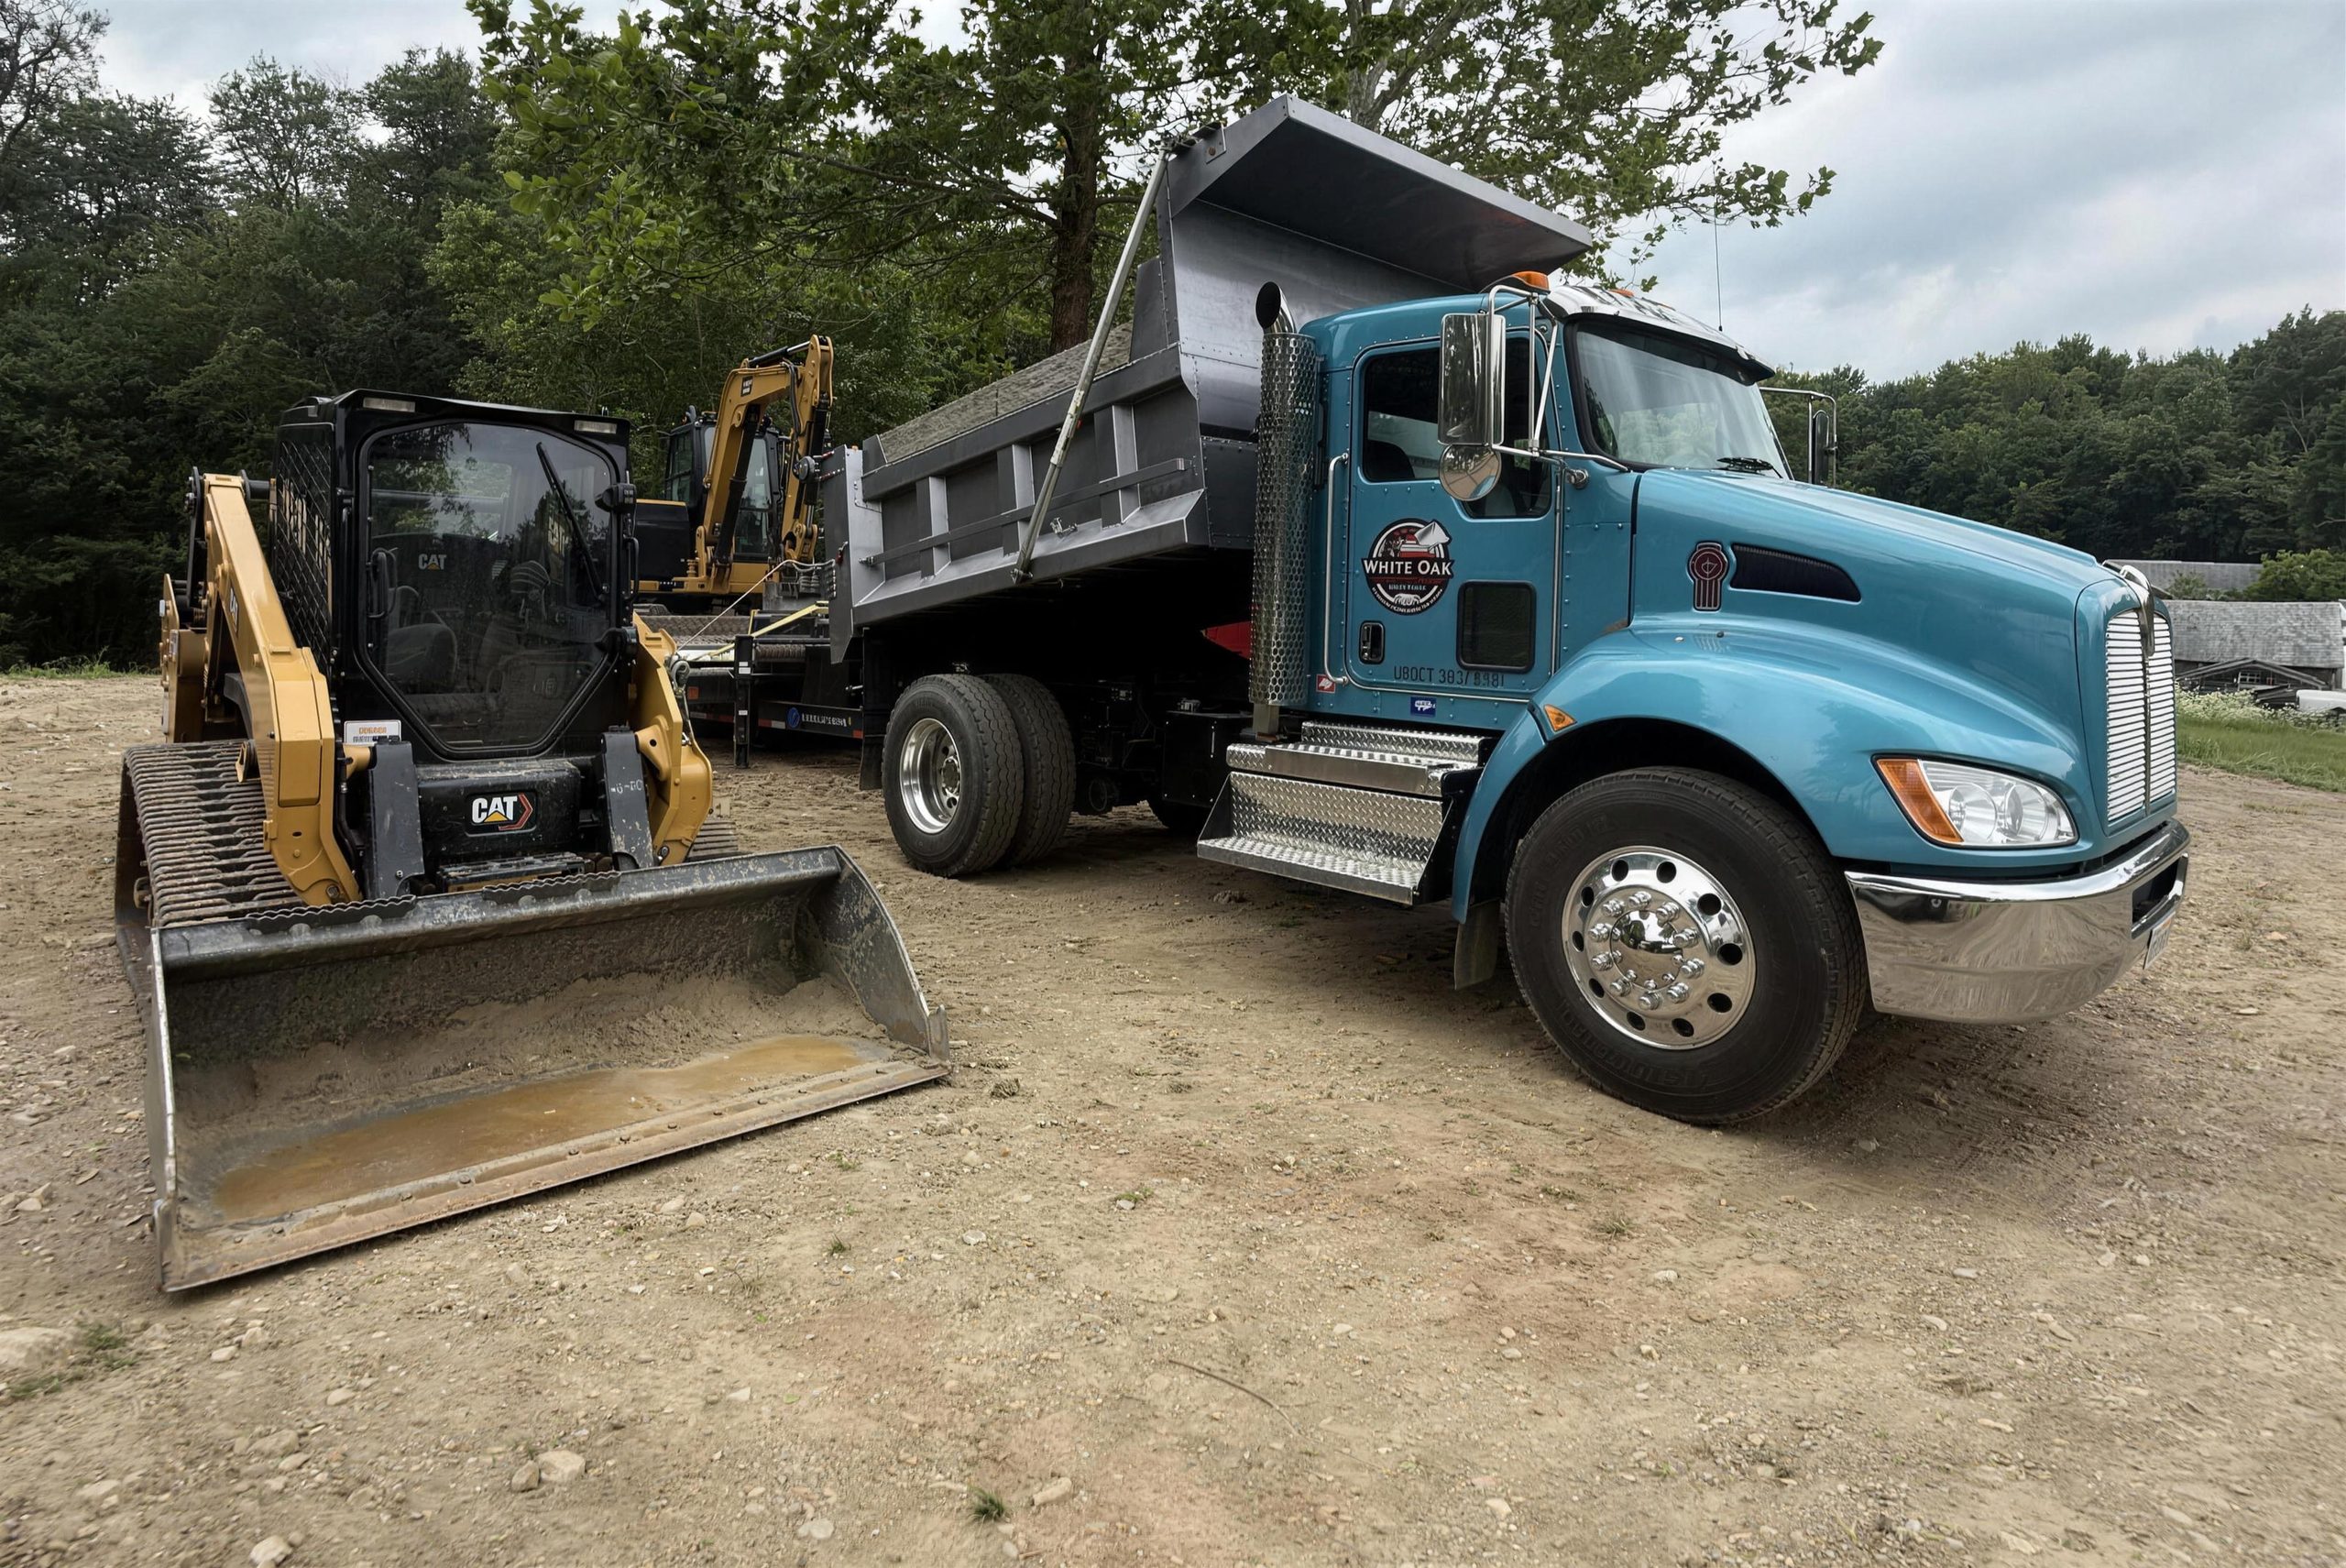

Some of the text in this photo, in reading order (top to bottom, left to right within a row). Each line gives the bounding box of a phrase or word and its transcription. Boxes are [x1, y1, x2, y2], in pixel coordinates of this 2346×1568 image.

[419, 554, 447, 570] CAT
[1364, 560, 1452, 576] WHITE OAK
[472, 795, 518, 824] CAT
